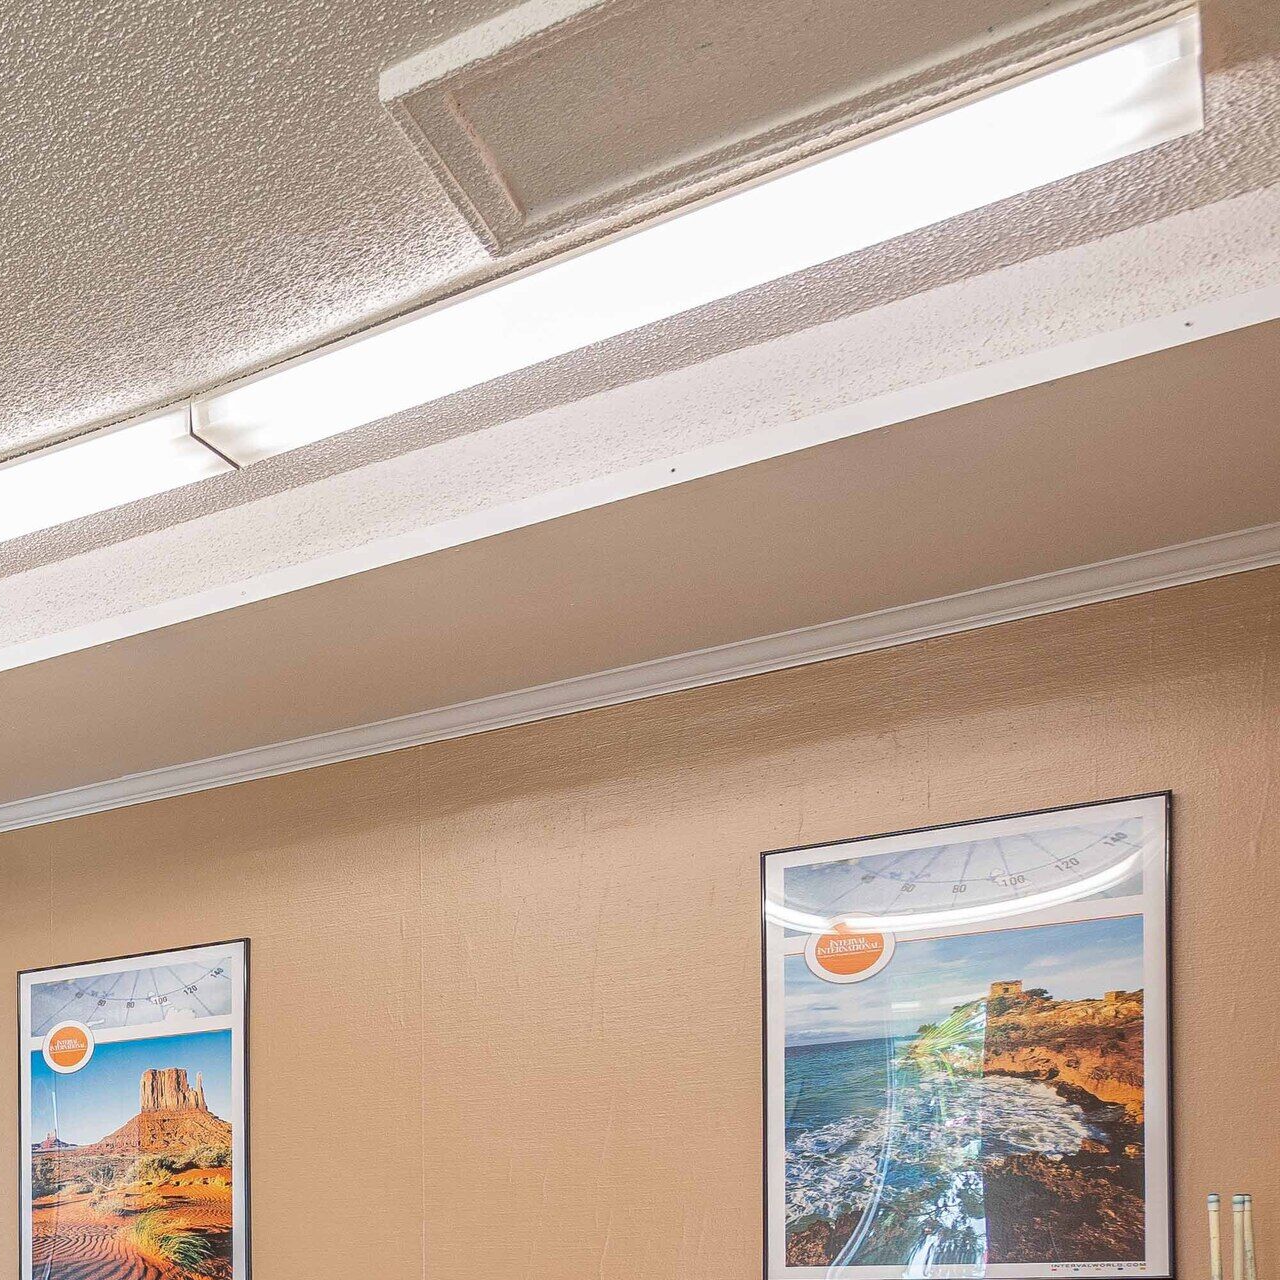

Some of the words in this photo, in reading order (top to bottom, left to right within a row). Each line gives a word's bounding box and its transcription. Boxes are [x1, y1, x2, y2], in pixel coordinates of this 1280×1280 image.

[1103, 831, 1129, 847] 140
[1055, 856, 1080, 872] 120
[1002, 874, 1026, 888] 100
[900, 882, 914, 893] 60
[952, 883, 967, 894] 80
[210, 967, 224, 979] 140
[183, 985, 198, 996] 120
[97, 999, 106, 1007] 60
[126, 1001, 135, 1009] 80
[153, 996, 168, 1005] 100
